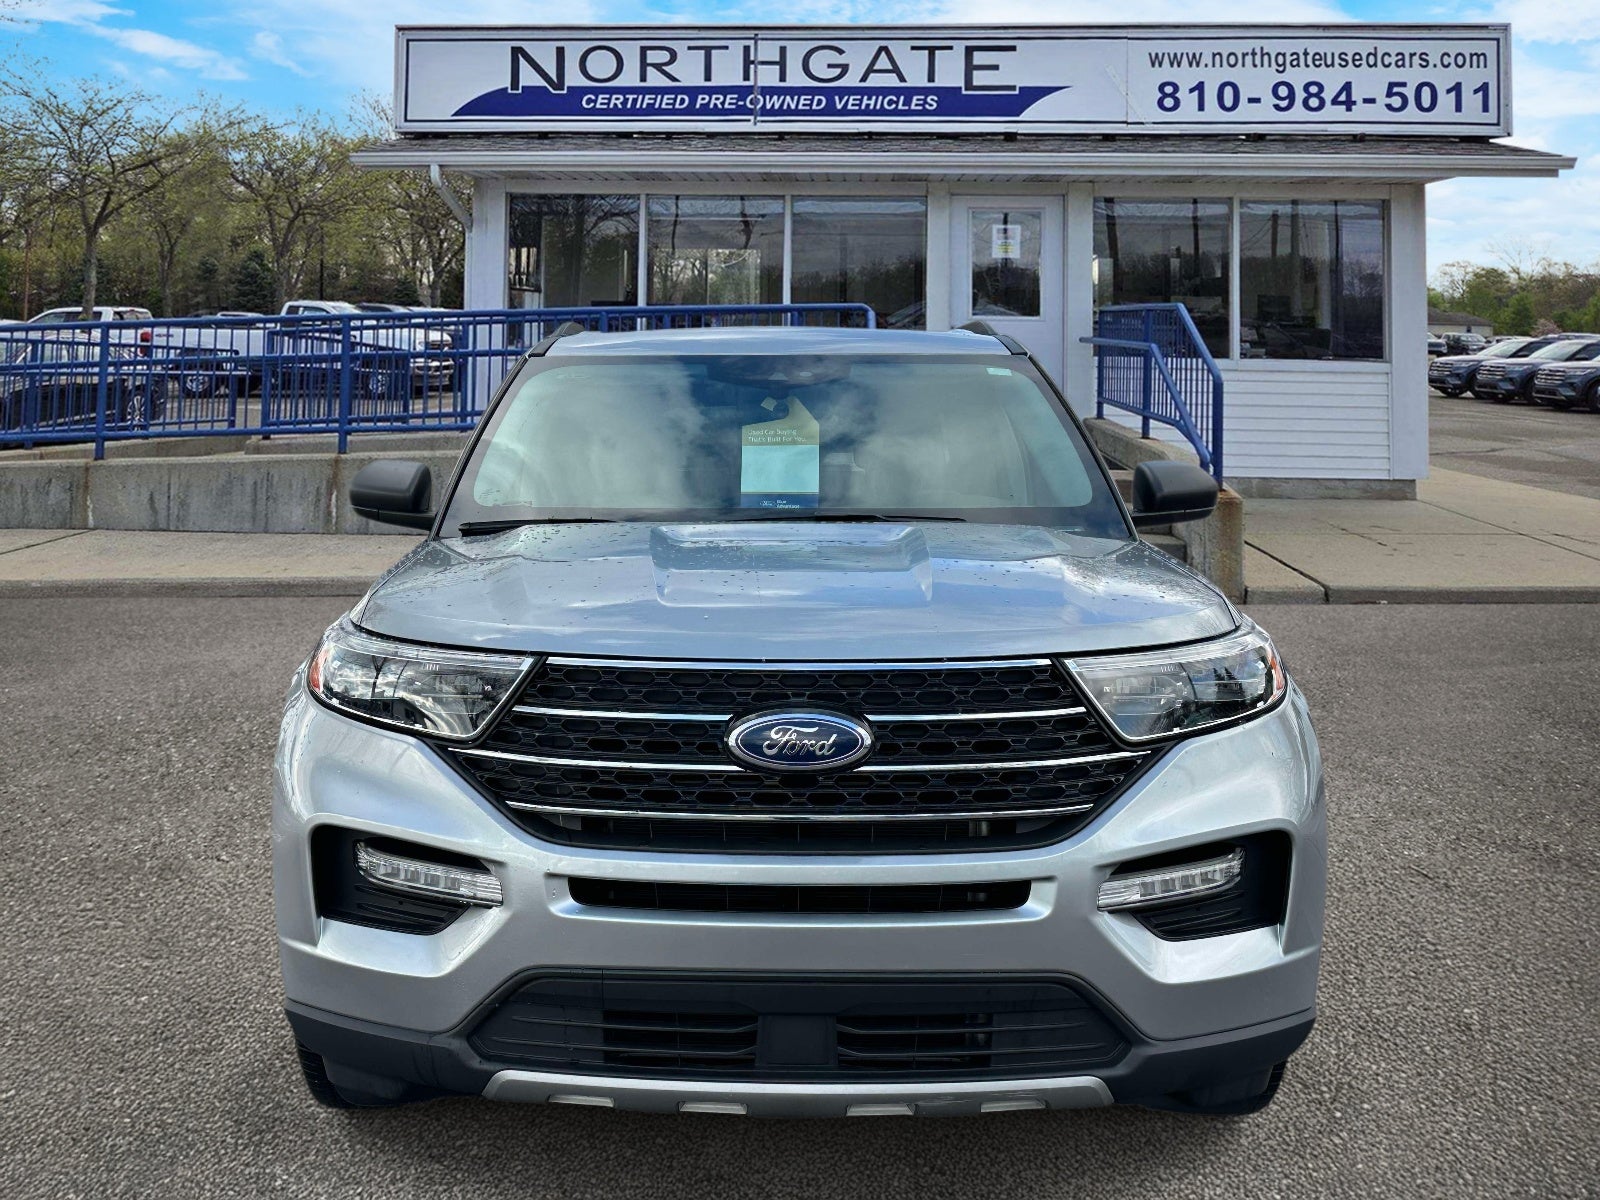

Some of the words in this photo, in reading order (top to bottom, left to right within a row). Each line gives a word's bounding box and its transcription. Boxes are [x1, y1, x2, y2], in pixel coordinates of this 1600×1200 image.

[510, 44, 1017, 92] NORTHGATE
[1148, 46, 1488, 73] www.northgateusedcars.com
[581, 94, 689, 110] CERTIFIED
[695, 95, 827, 111] PRE-OWNED
[834, 95, 939, 111] VEHICLES
[1156, 80, 1491, 113] 810-984-5011
[762, 725, 838, 756] Ford
